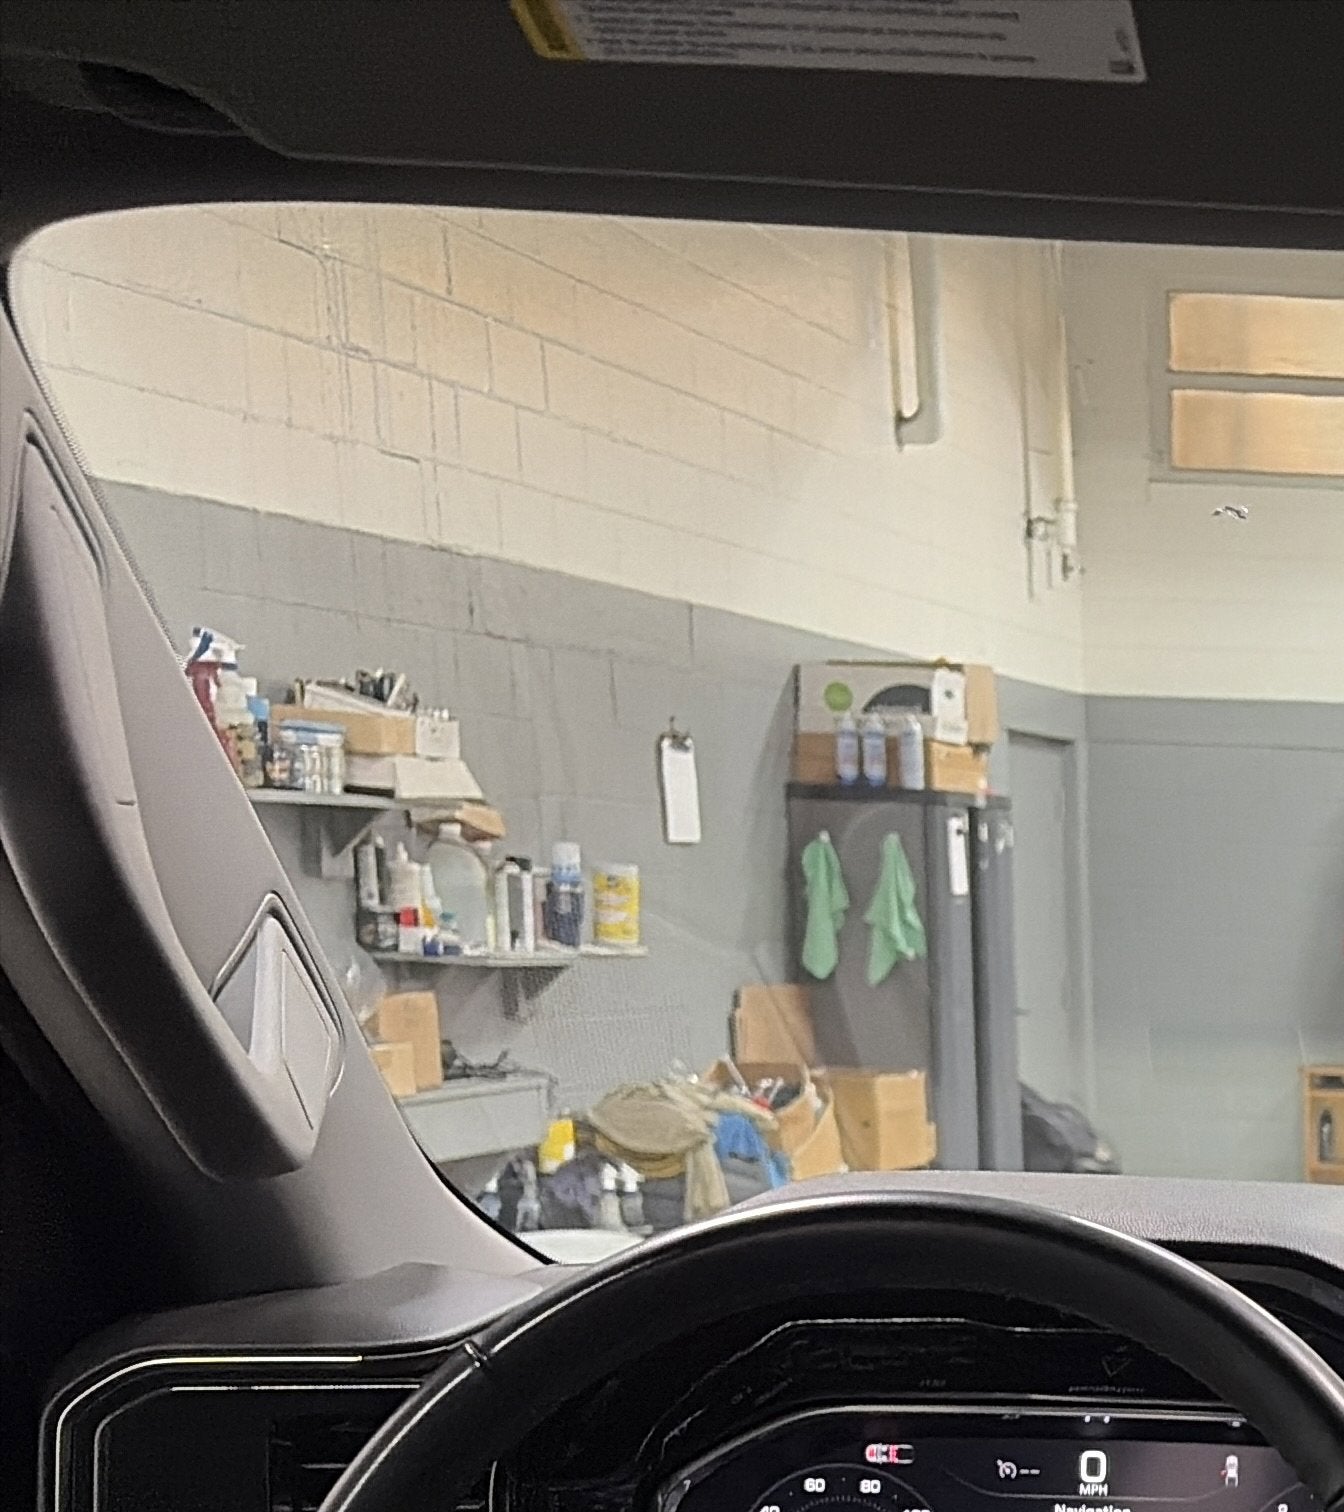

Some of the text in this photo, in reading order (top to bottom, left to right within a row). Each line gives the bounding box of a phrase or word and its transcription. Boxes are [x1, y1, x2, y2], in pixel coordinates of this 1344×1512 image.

[1080, 1450, 1107, 1483] 0
[804, 1478, 825, 1492] 60
[860, 1480, 881, 1493] 80
[1079, 1483, 1108, 1496] MPH
